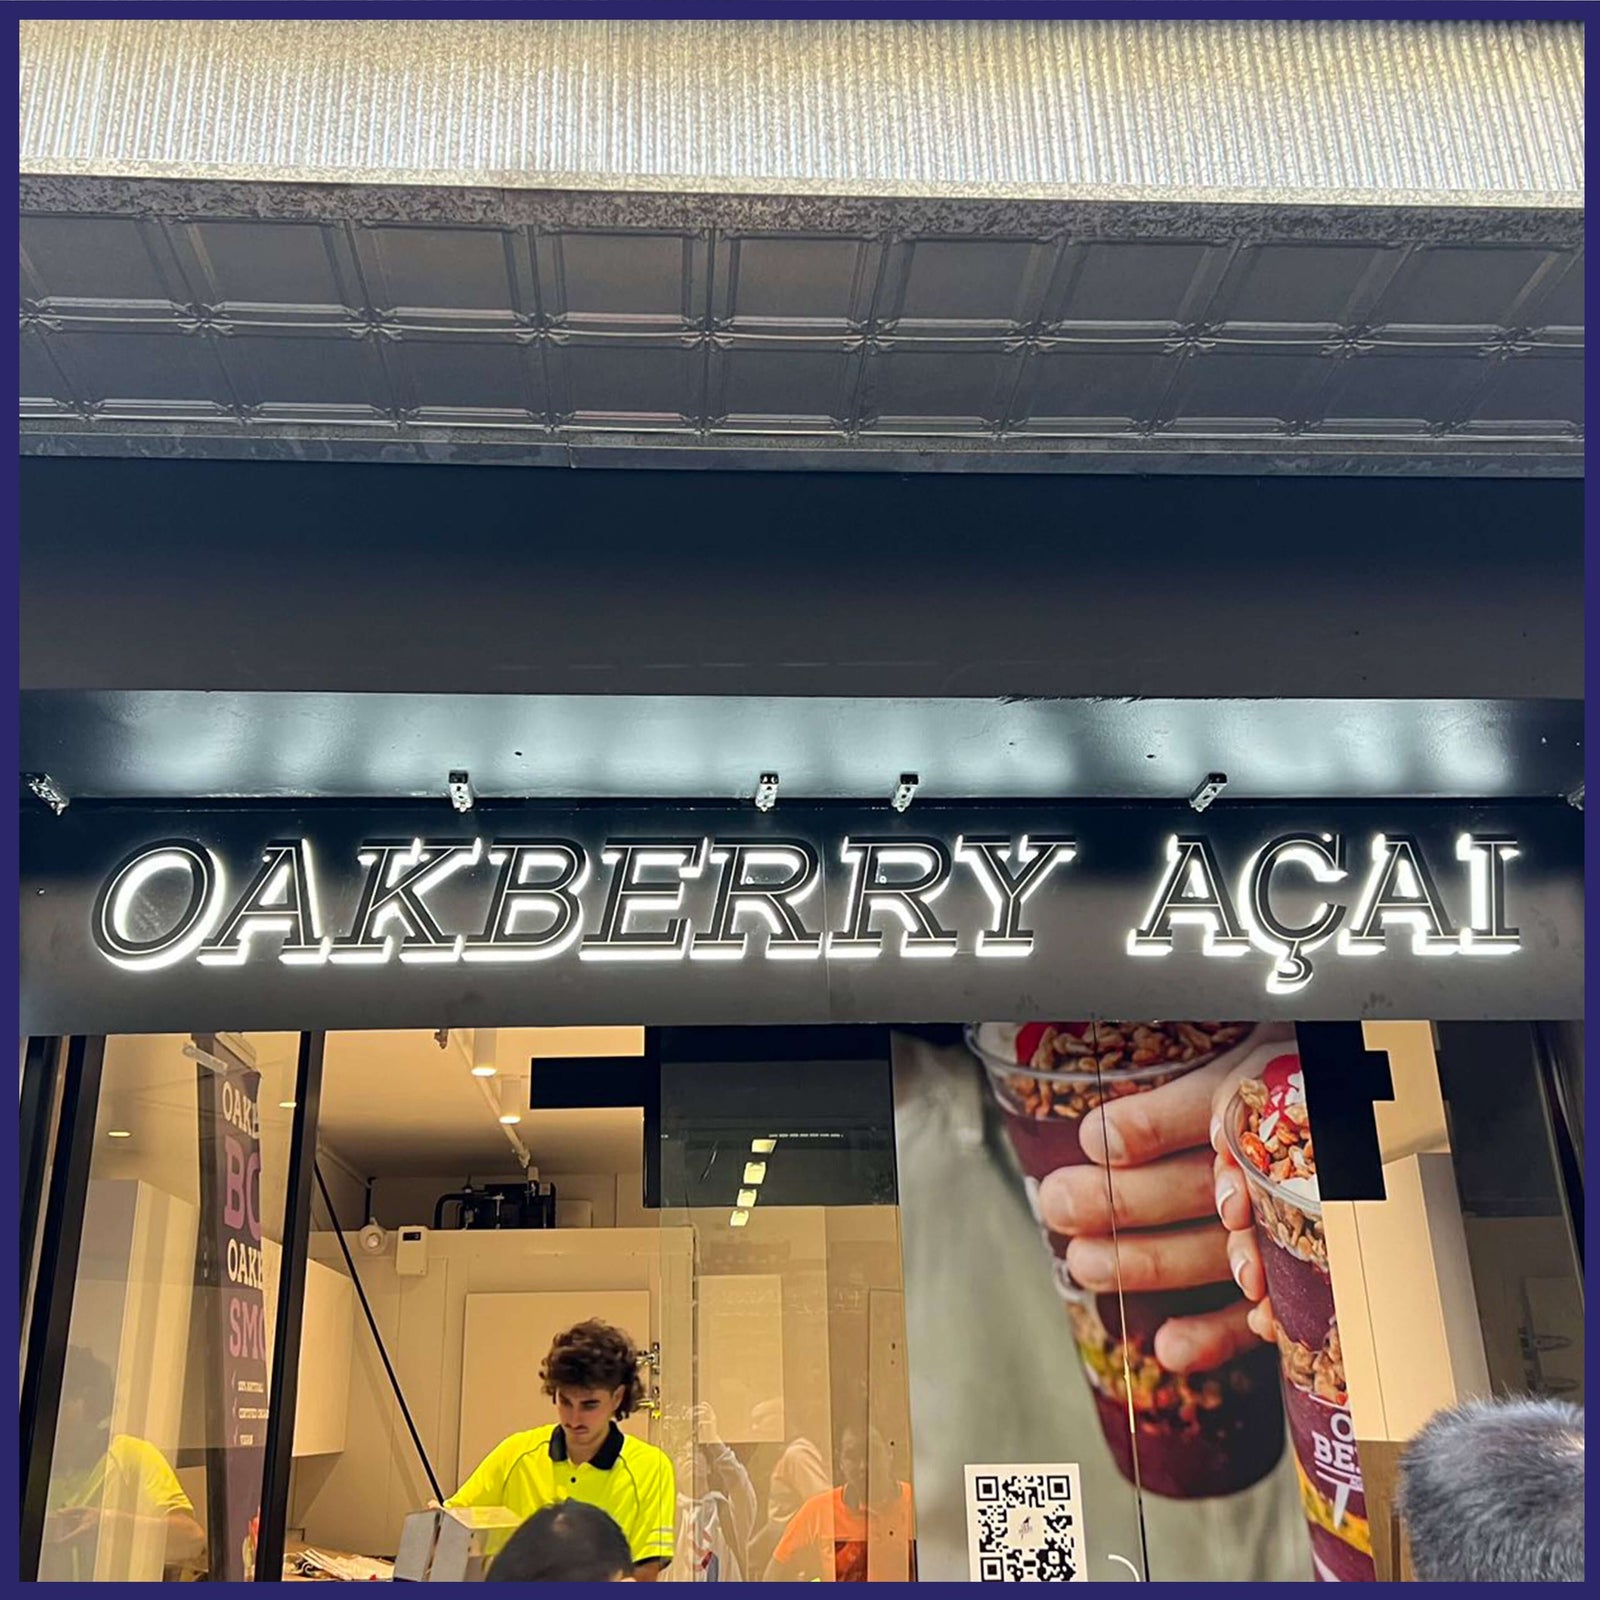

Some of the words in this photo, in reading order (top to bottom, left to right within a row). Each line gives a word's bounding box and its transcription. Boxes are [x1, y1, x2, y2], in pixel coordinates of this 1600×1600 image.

[91, 836, 1077, 969] OAKBERRY
[1127, 833, 1522, 993] AÇAI
[1311, 1430, 1361, 1475] BE
